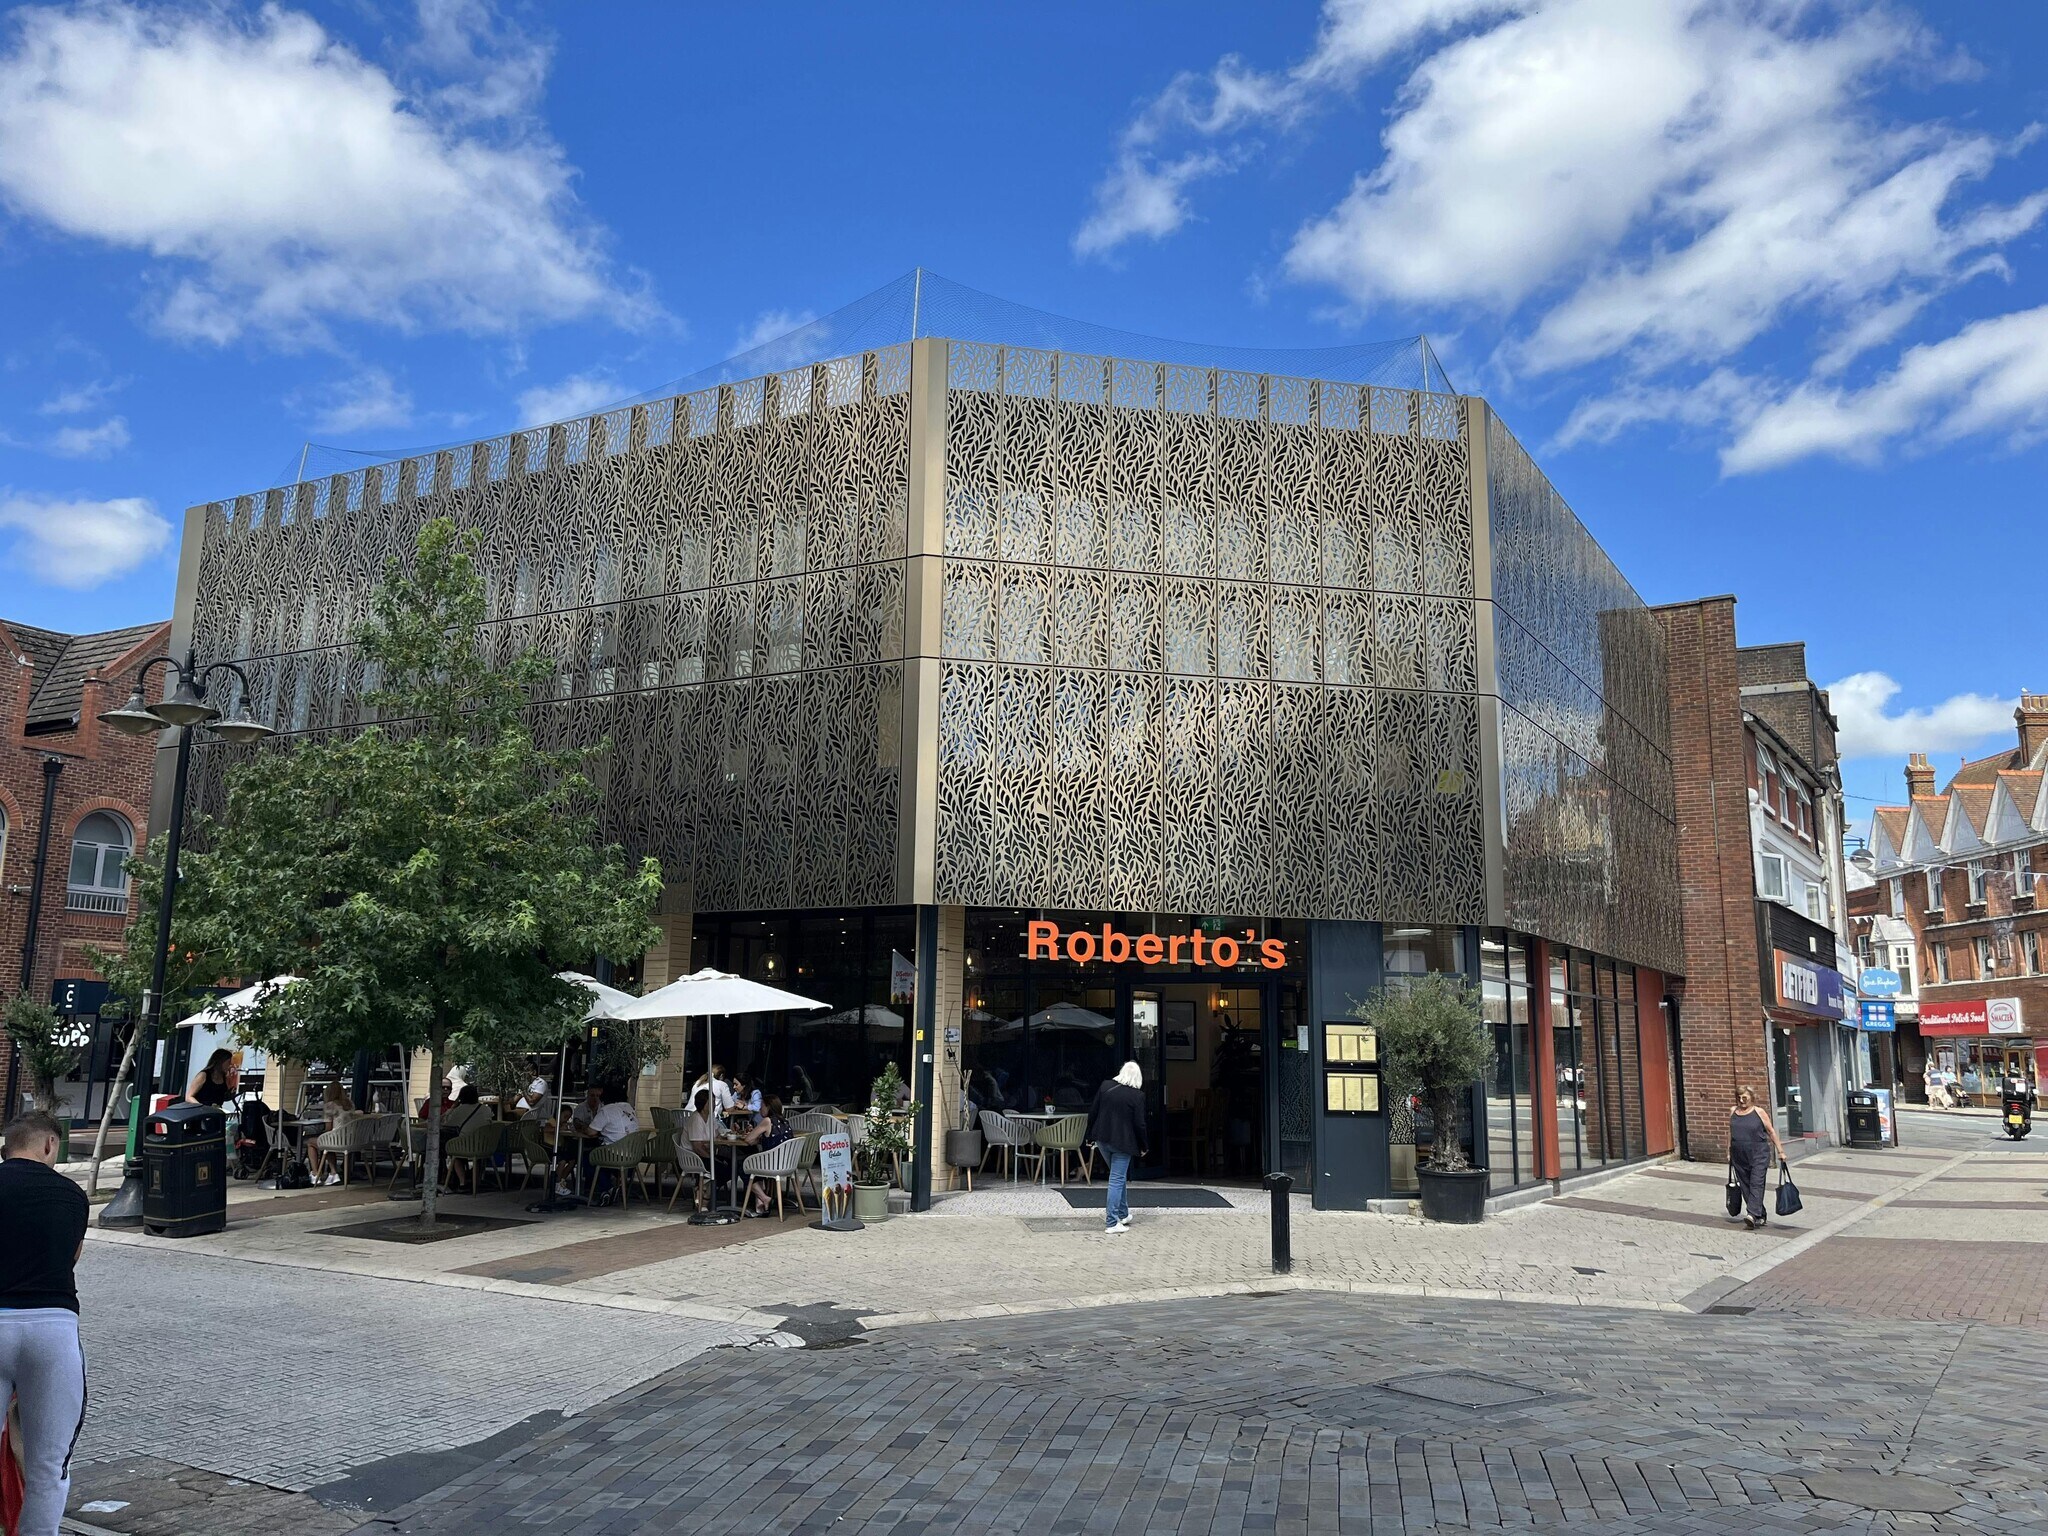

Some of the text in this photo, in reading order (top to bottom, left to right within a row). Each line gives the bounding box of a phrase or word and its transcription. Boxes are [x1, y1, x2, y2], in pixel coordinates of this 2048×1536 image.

[1027, 920, 1287, 969] Roberto's
[1781, 961, 1818, 1005] BETFRED
[66, 990, 74, 1002] C
[1920, 1011, 1986, 1025] Traditional Polish Food
[821, 1140, 849, 1151] DiSotto's
